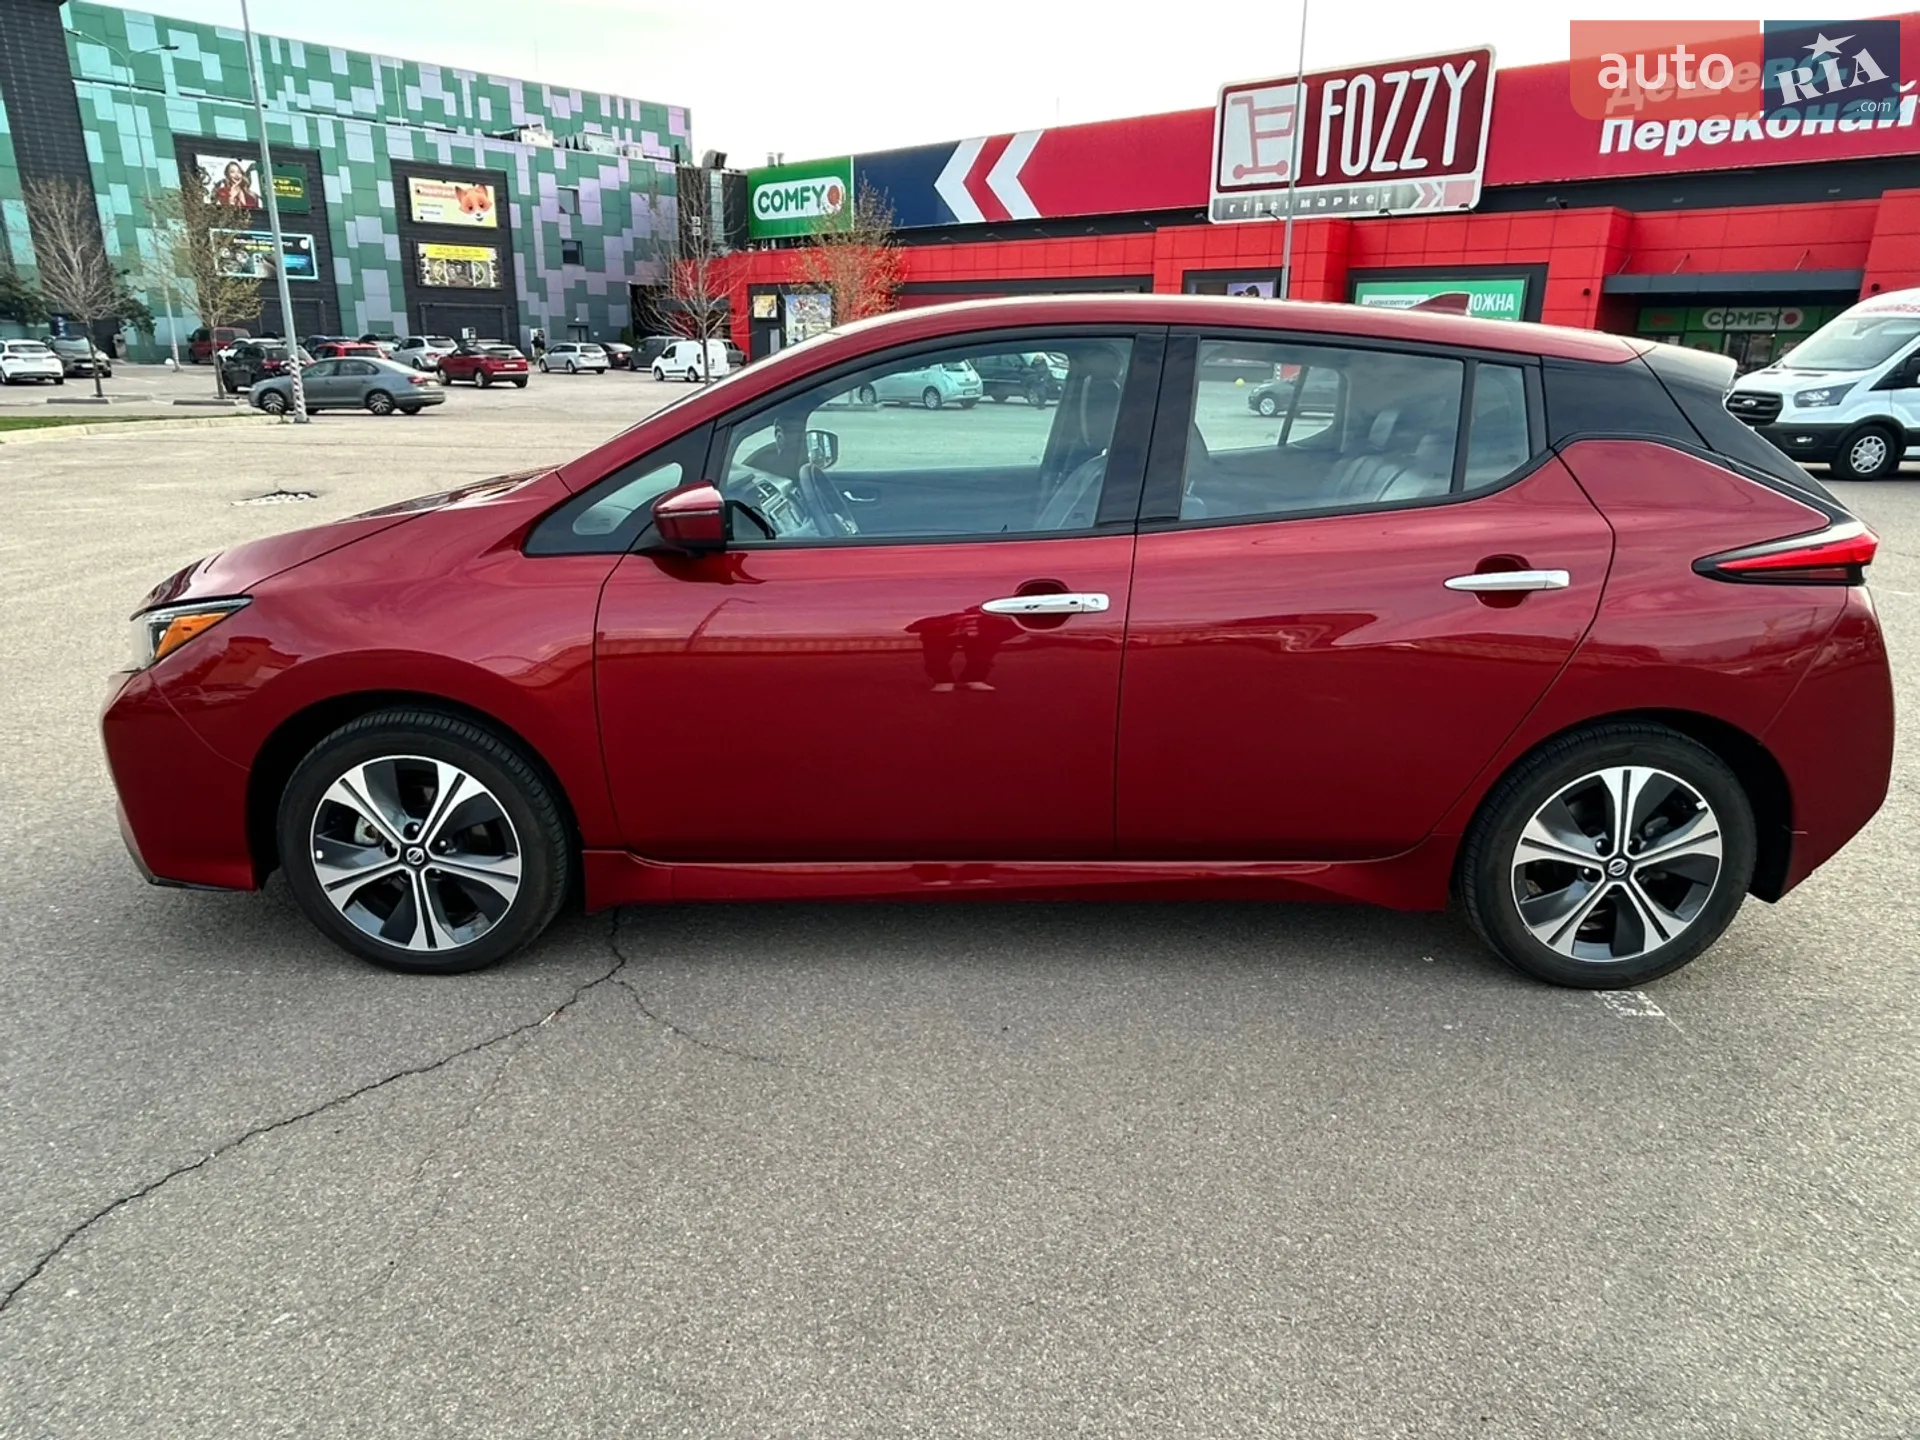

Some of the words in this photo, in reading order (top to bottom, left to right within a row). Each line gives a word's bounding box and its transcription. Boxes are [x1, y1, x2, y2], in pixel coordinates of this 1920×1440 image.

[1316, 59, 1477, 177] FOZZY
[1599, 80, 1920, 156] Переконай
[757, 184, 826, 214] COMFY
[1468, 293, 1514, 312] ОЖНА
[1708, 311, 1780, 326] COMFY
